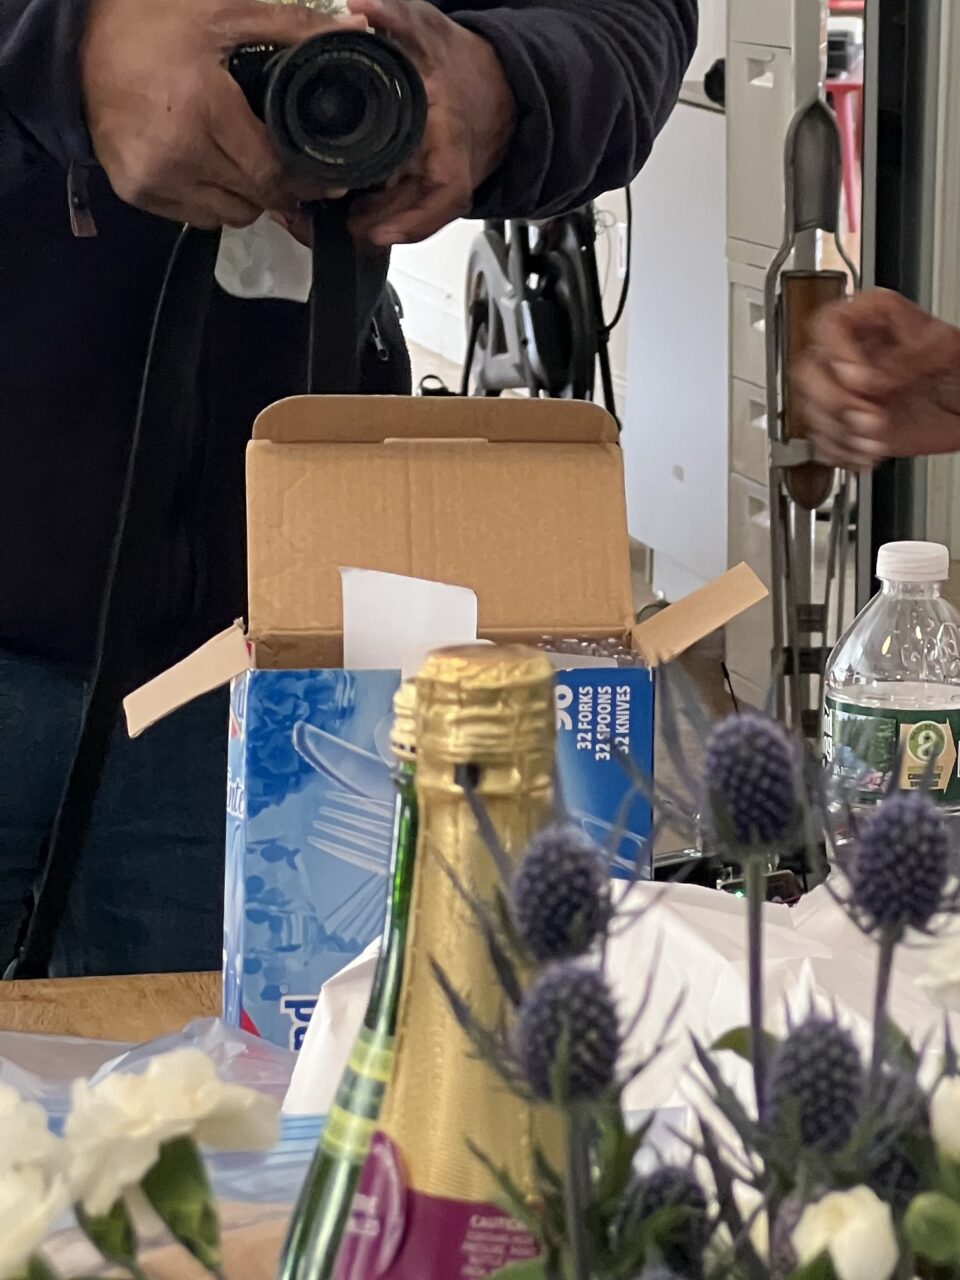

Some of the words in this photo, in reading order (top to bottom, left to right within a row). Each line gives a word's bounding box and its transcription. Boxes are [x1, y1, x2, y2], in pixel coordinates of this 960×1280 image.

[579, 686, 593, 729] FORKS
[597, 685, 612, 739] SPOONS
[615, 685, 631, 733] KNIVES
[577, 732, 592, 750] 32
[595, 743, 611, 761] 32
